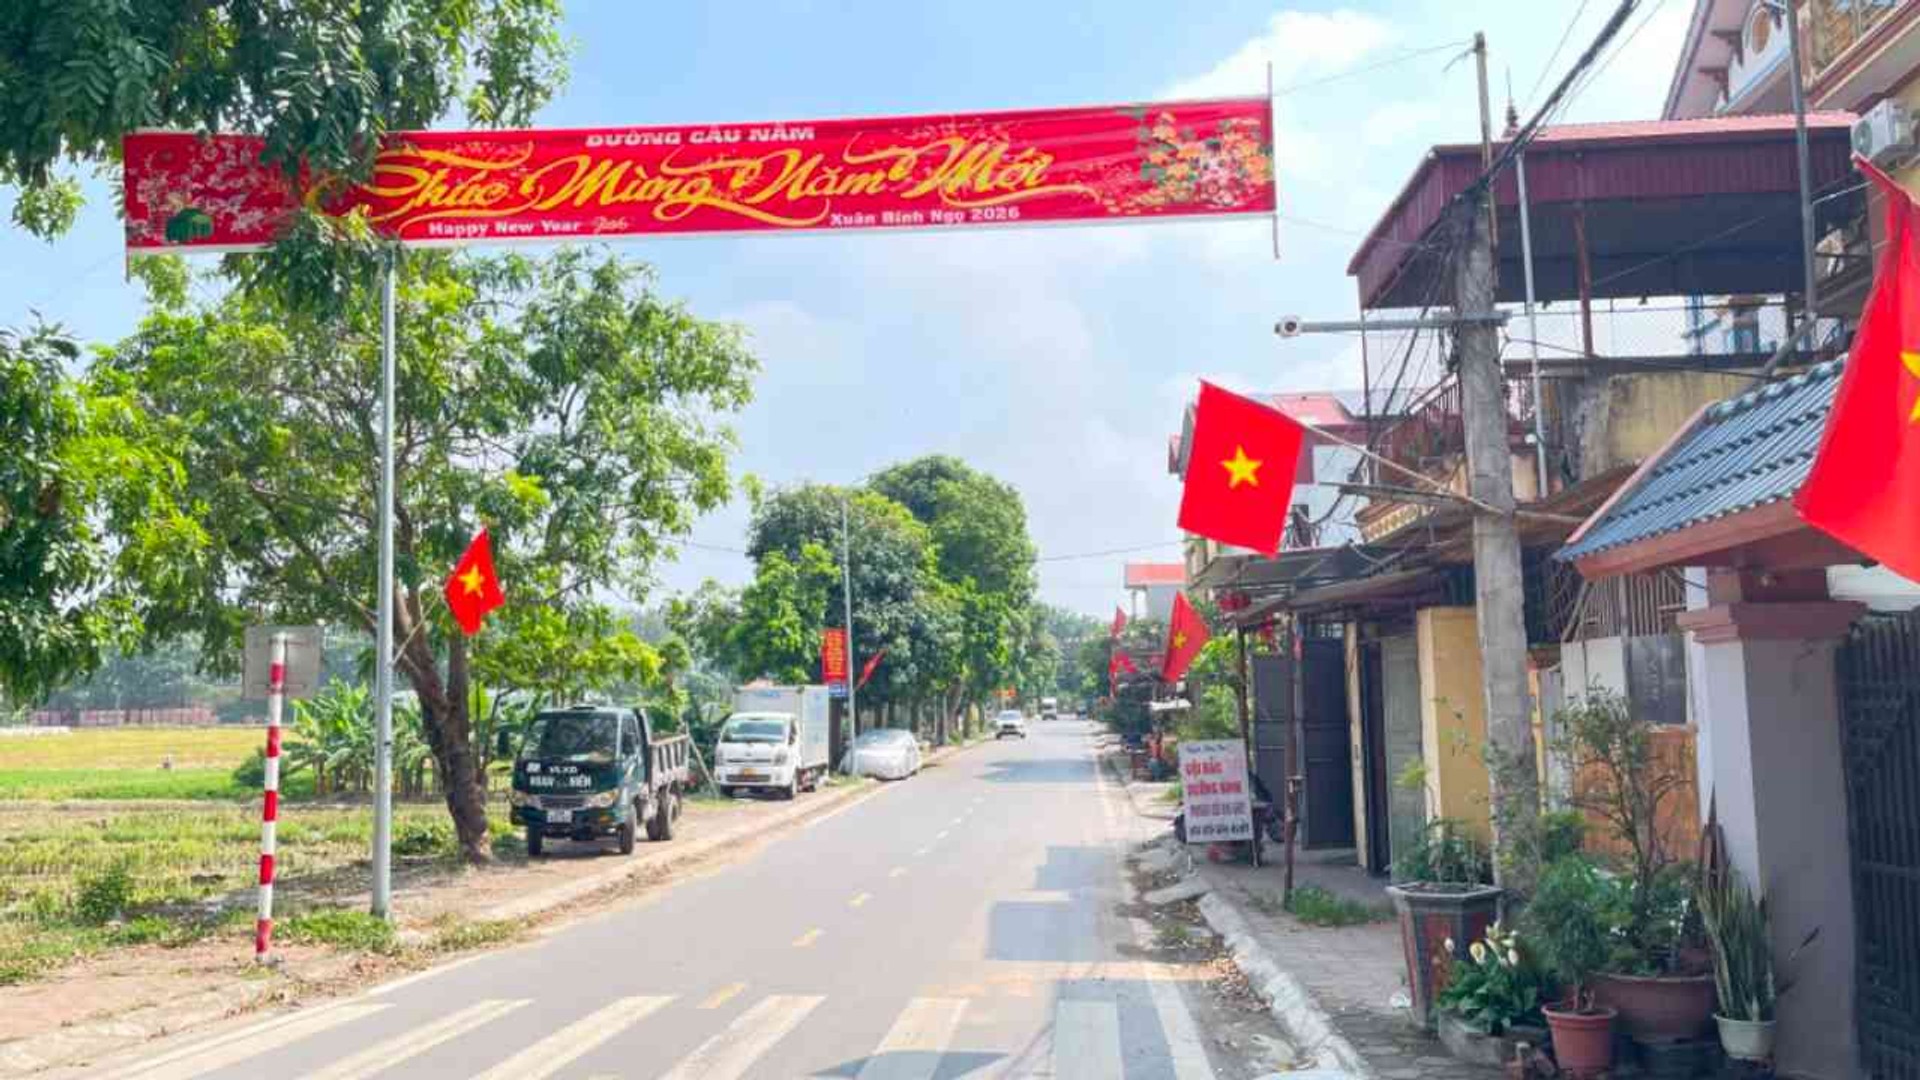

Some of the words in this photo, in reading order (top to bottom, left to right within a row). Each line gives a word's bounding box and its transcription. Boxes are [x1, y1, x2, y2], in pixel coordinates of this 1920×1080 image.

[729, 149, 888, 204] Năm
[830, 212, 876, 226] Xuân
[971, 205, 1020, 220] 2026
[428, 221, 488, 238] Happy
[495, 220, 534, 233] New
[541, 219, 579, 232] Year
